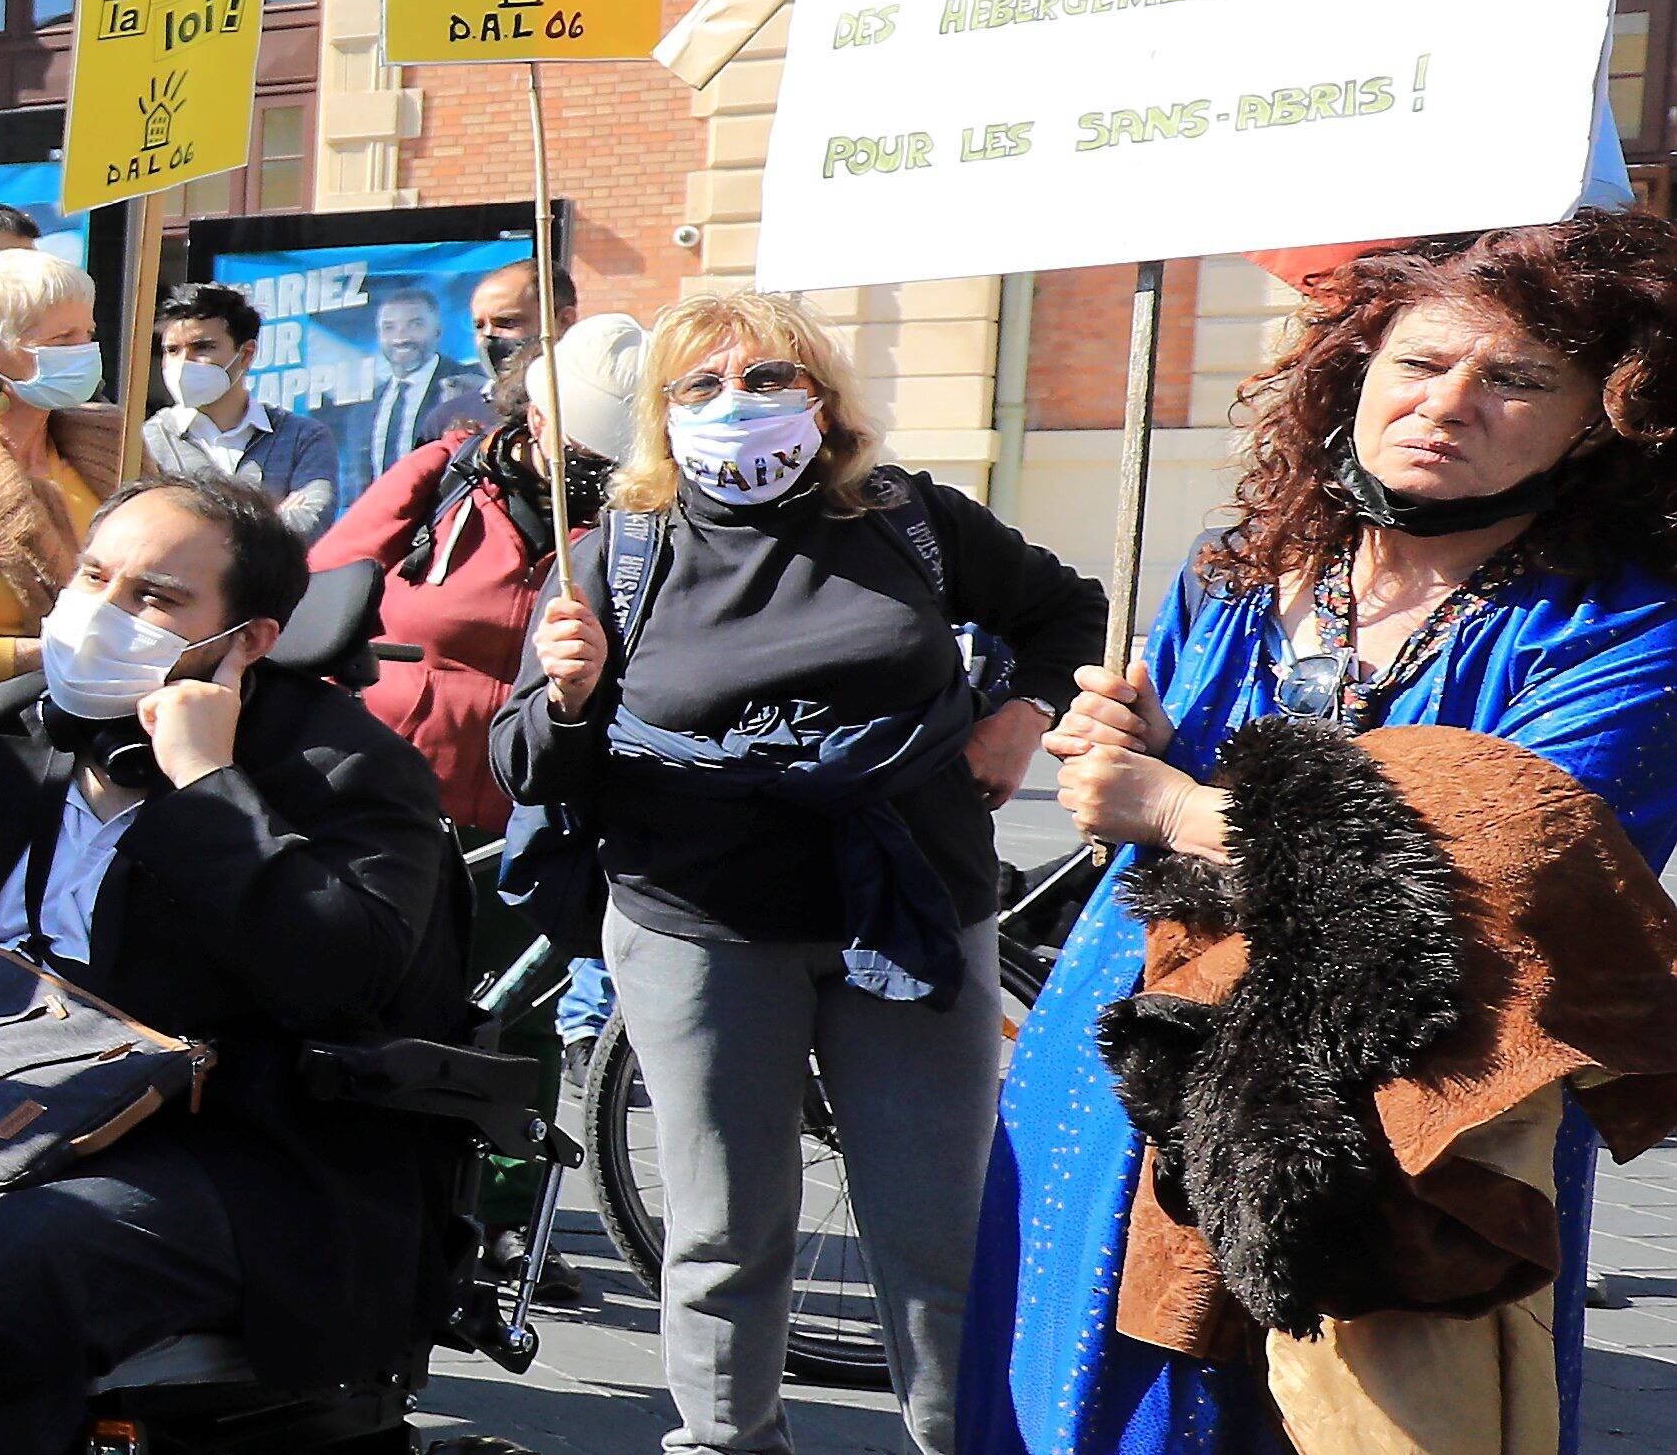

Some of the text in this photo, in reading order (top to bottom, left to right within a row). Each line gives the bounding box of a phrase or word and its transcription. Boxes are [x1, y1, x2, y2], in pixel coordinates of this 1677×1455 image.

[107, 5, 140, 34] la
[544, 10, 584, 38] 06
[832, 3, 901, 50] DES
[822, 136, 933, 179] POUR
[960, 121, 1033, 163] LES
[250, 261, 369, 320] ARIEZ
[251, 322, 303, 369] UR
[244, 357, 376, 412] 'APPLI
